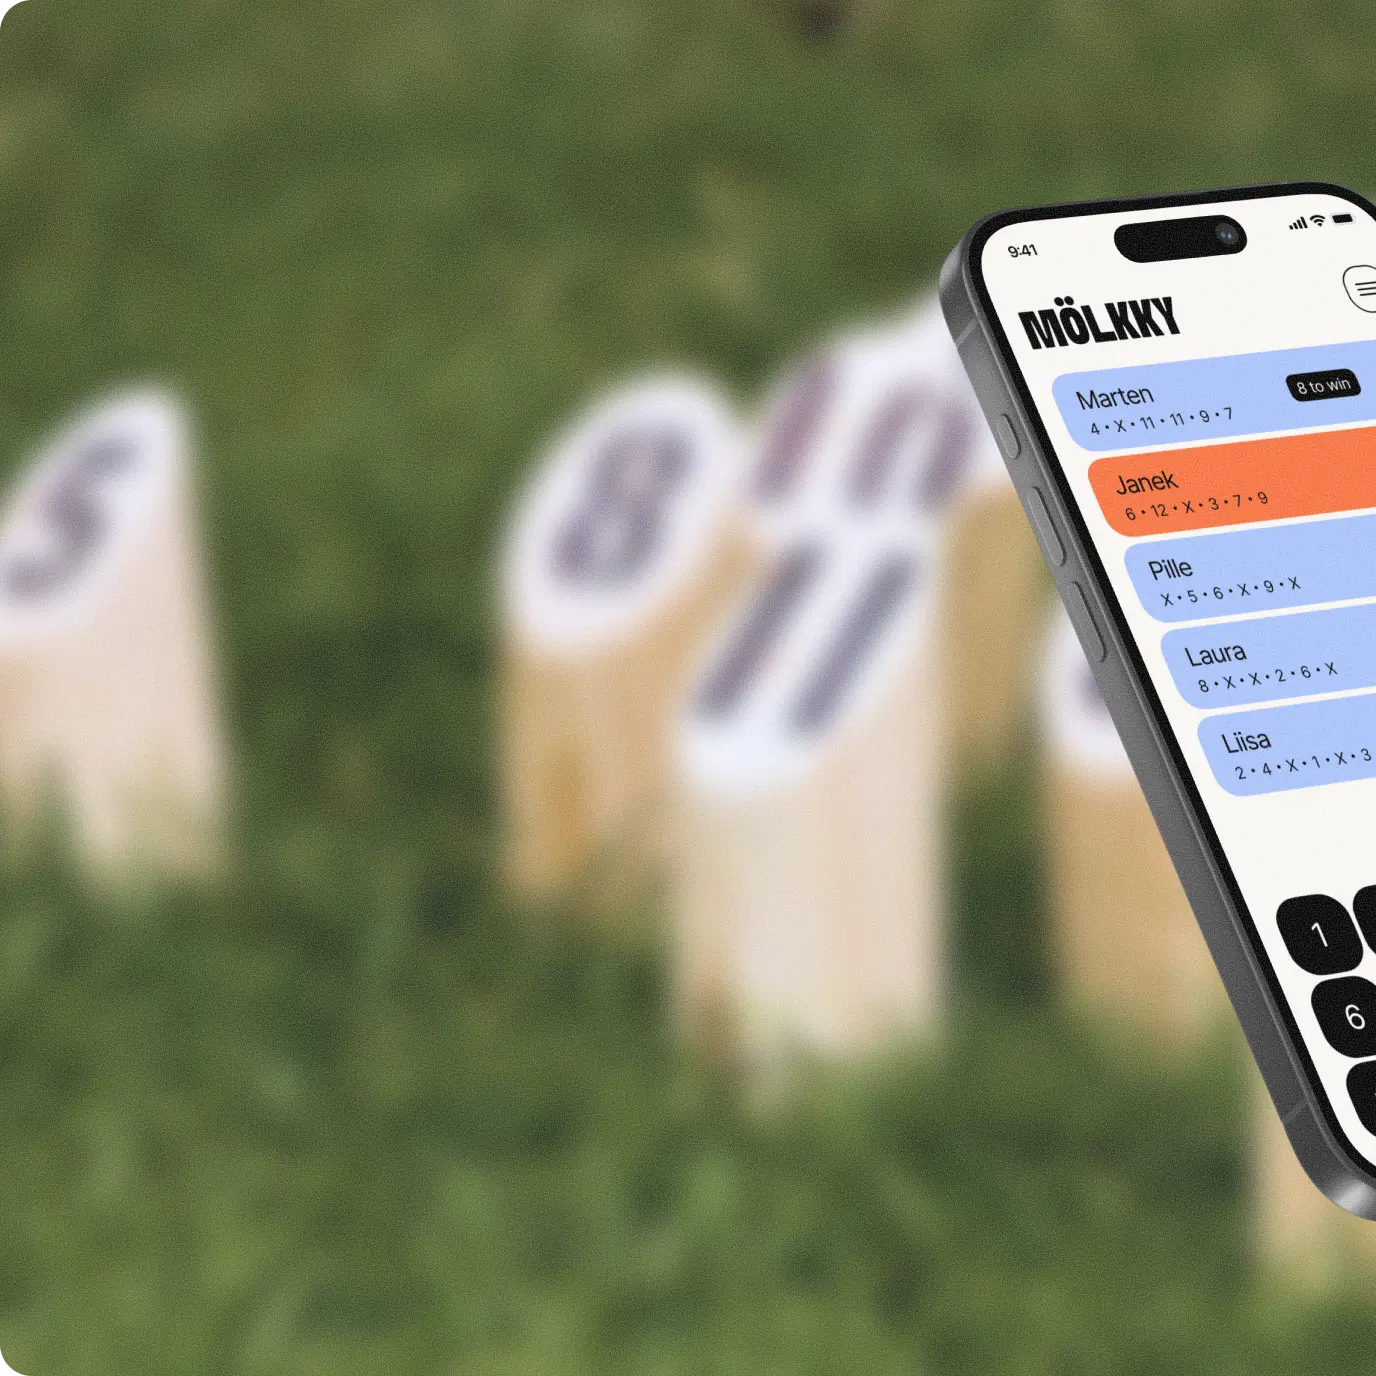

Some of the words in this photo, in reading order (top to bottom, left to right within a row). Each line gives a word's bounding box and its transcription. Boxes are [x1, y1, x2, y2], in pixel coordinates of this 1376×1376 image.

[1008, 244, 1037, 258] 9:41
[1018, 296, 1181, 350] MÖLKKY
[1076, 388, 1154, 410] Marten
[1297, 382, 1307, 394] 8
[1309, 382, 1324, 392] to
[1327, 380, 1351, 390] win
[1091, 423, 1099, 434] 4
[1114, 420, 1126, 432] X
[1140, 417, 1155, 429] 11
[1170, 413, 1184, 425] 11
[1199, 410, 1209, 422] 9
[1224, 407, 1232, 419] 7
[1117, 471, 1178, 495] Janek
[1126, 508, 1136, 520] 6
[1151, 504, 1168, 516] 12
[1183, 501, 1194, 513] X
[1209, 498, 1219, 510] 3
[1233, 494, 1240, 507] 7
[1258, 492, 1268, 504] 9
[1149, 559, 1193, 580] Pille
[1161, 594, 1173, 606] X
[1187, 590, 1198, 603] 5
[1213, 587, 1223, 599] 6
[1238, 584, 1250, 596] X
[1264, 580, 1274, 593] 9
[1288, 577, 1300, 589] X
[1185, 645, 1247, 666] Laura
[1198, 680, 1209, 692] 8
[1223, 676, 1235, 689] X
[1249, 673, 1261, 685] X
[1275, 669, 1285, 682] 2
[1301, 666, 1311, 678] 6
[1325, 663, 1337, 674] X
[1222, 732, 1271, 753] Liisa
[1235, 766, 1246, 779] 2
[1263, 763, 1271, 774] 4
[1286, 759, 1298, 772] X
[1312, 756, 1320, 768] 1
[1335, 752, 1347, 764] X
[1361, 748, 1371, 761] 3
[1312, 923, 1328, 946] 1
[1345, 1004, 1365, 1029] 6
